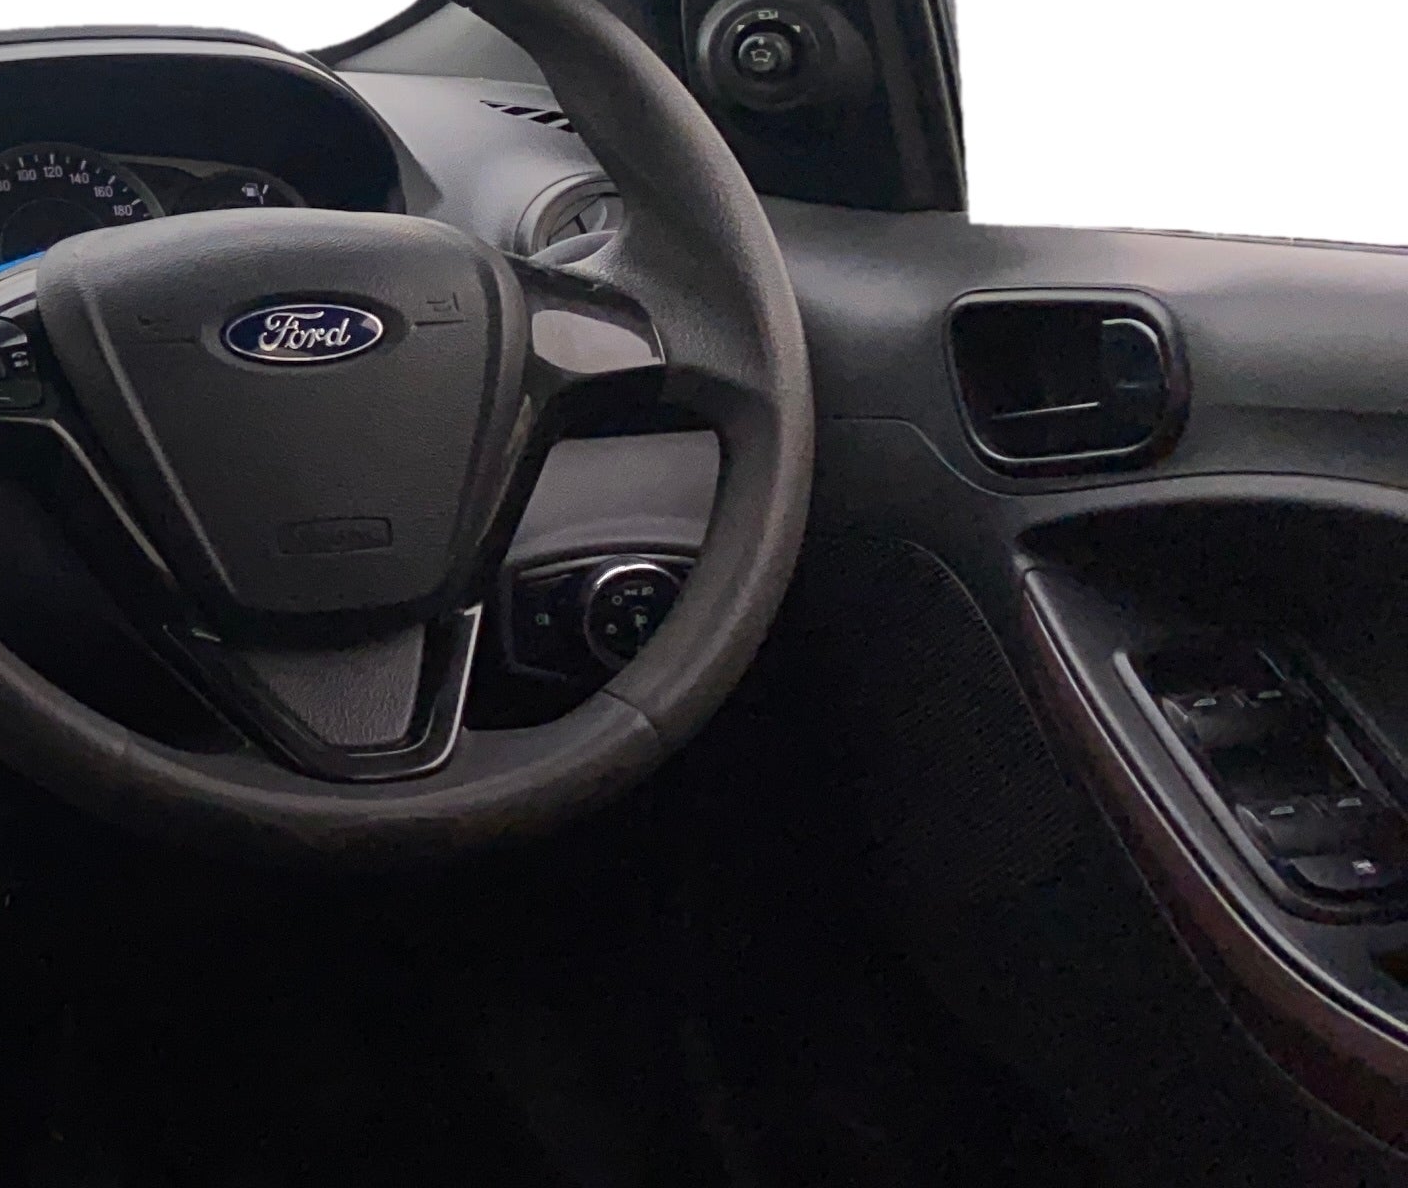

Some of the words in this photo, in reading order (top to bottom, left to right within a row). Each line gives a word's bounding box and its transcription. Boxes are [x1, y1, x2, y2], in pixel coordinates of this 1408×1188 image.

[17, 169, 36, 181] 100
[43, 165, 63, 178] 120
[69, 172, 90, 185] 140
[93, 185, 114, 198] 160
[112, 204, 133, 217] 180
[258, 311, 351, 351] Ford
